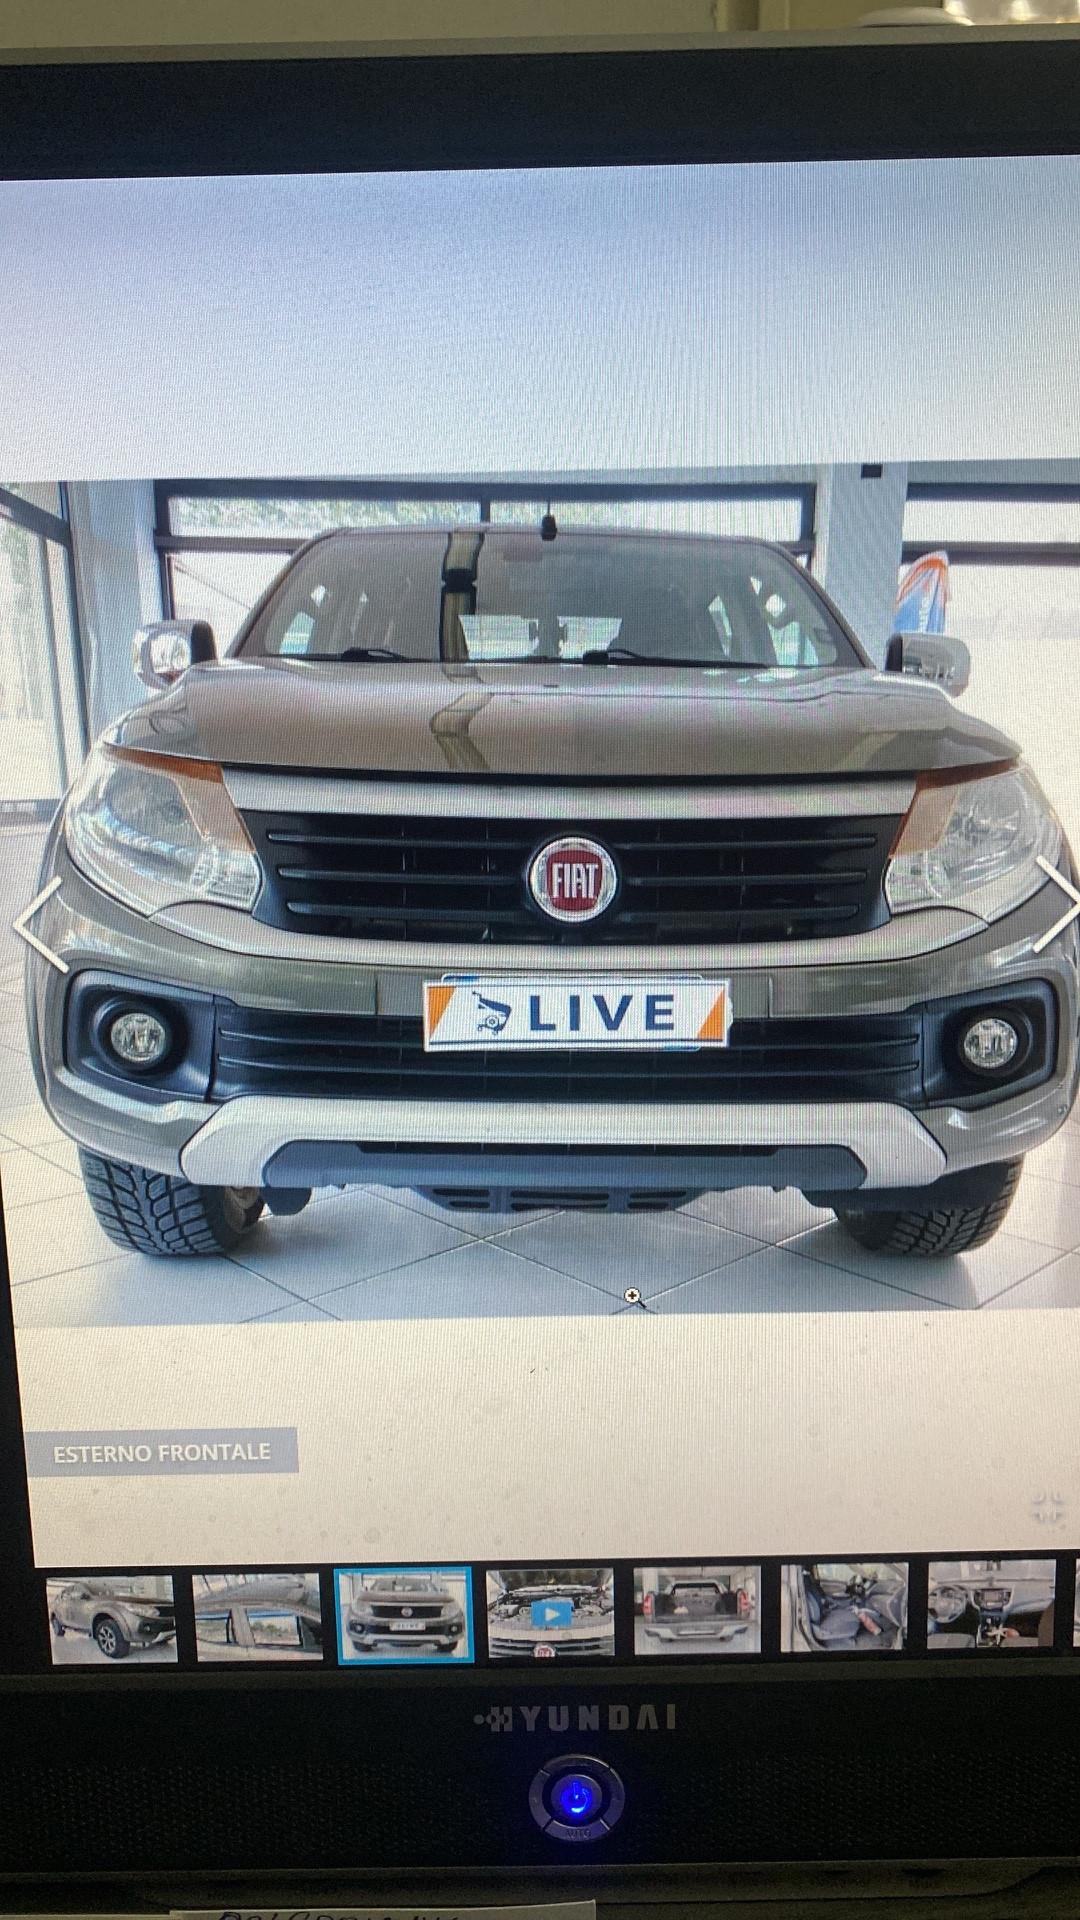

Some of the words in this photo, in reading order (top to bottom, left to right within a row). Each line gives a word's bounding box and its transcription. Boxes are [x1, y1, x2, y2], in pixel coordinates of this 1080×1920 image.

[551, 862, 599, 899] FIAT
[529, 994, 675, 1032] LIVE
[53, 1444, 152, 1464] ESTERNO
[158, 1442, 271, 1463] FRONTALE
[488, 1703, 676, 1732] HYUNDAI
